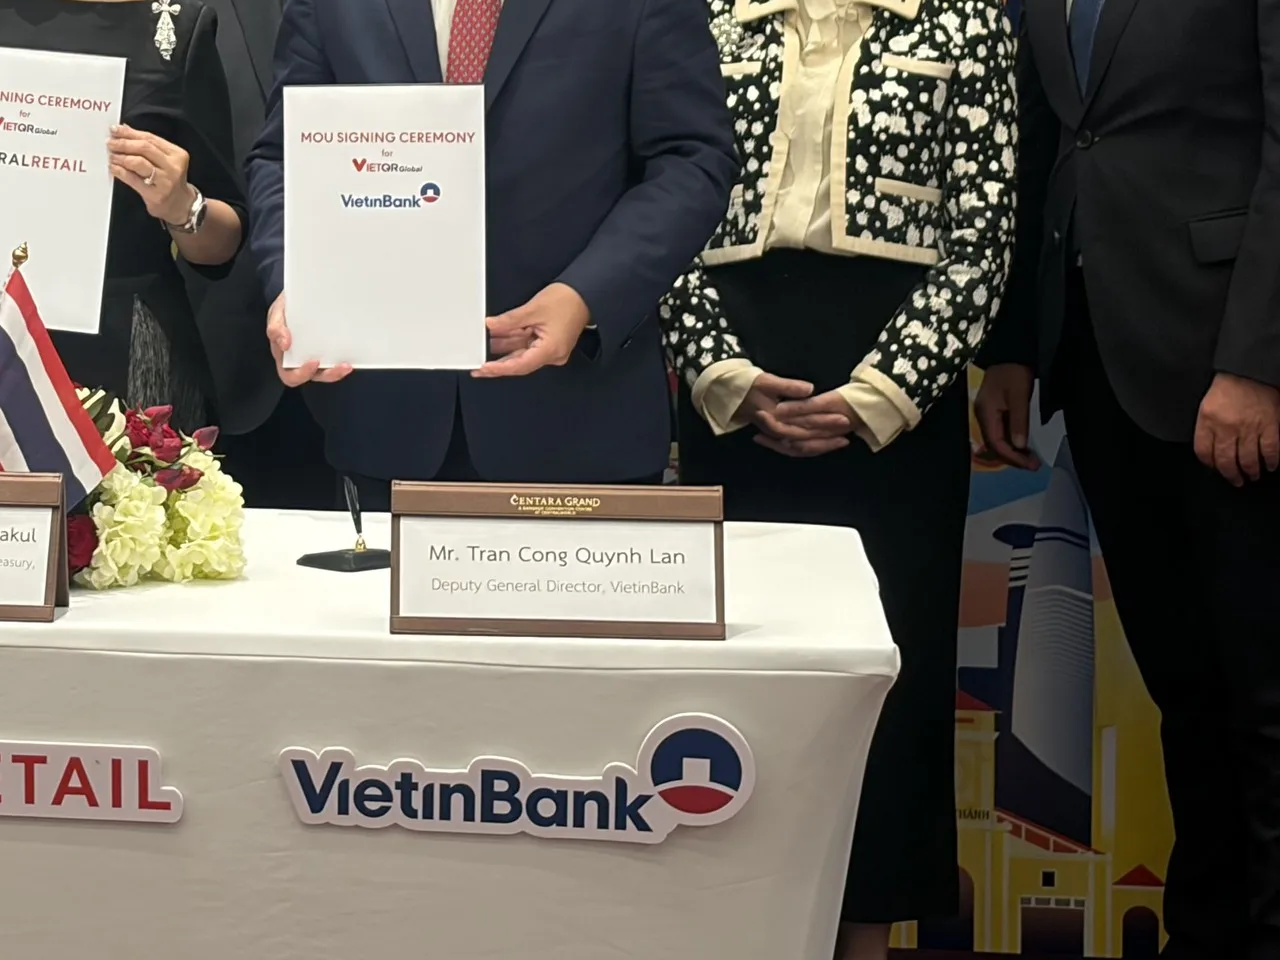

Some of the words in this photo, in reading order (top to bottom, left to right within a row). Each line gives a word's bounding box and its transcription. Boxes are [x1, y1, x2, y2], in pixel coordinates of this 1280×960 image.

[38, 95, 111, 112] CEREMONY
[35, 127, 58, 136] Global
[301, 132, 333, 143] MOU
[337, 132, 395, 143] SIGNING
[400, 132, 475, 143] CEREMONY
[382, 149, 393, 157] for
[352, 158, 398, 172] VIETQR
[341, 194, 421, 208] VietinBank
[510, 494, 561, 505] CENTARA
[564, 497, 600, 508] GRAND
[430, 545, 459, 561] Mr.
[467, 546, 510, 561] Tran
[519, 547, 567, 567] Cong
[576, 548, 641, 567] Quynh
[651, 549, 685, 564] Lan
[432, 578, 482, 594] Deputy
[487, 579, 541, 592] General
[547, 580, 605, 594] Director,
[610, 581, 685, 594] VietinBank
[291, 759, 654, 833] VietinBank
